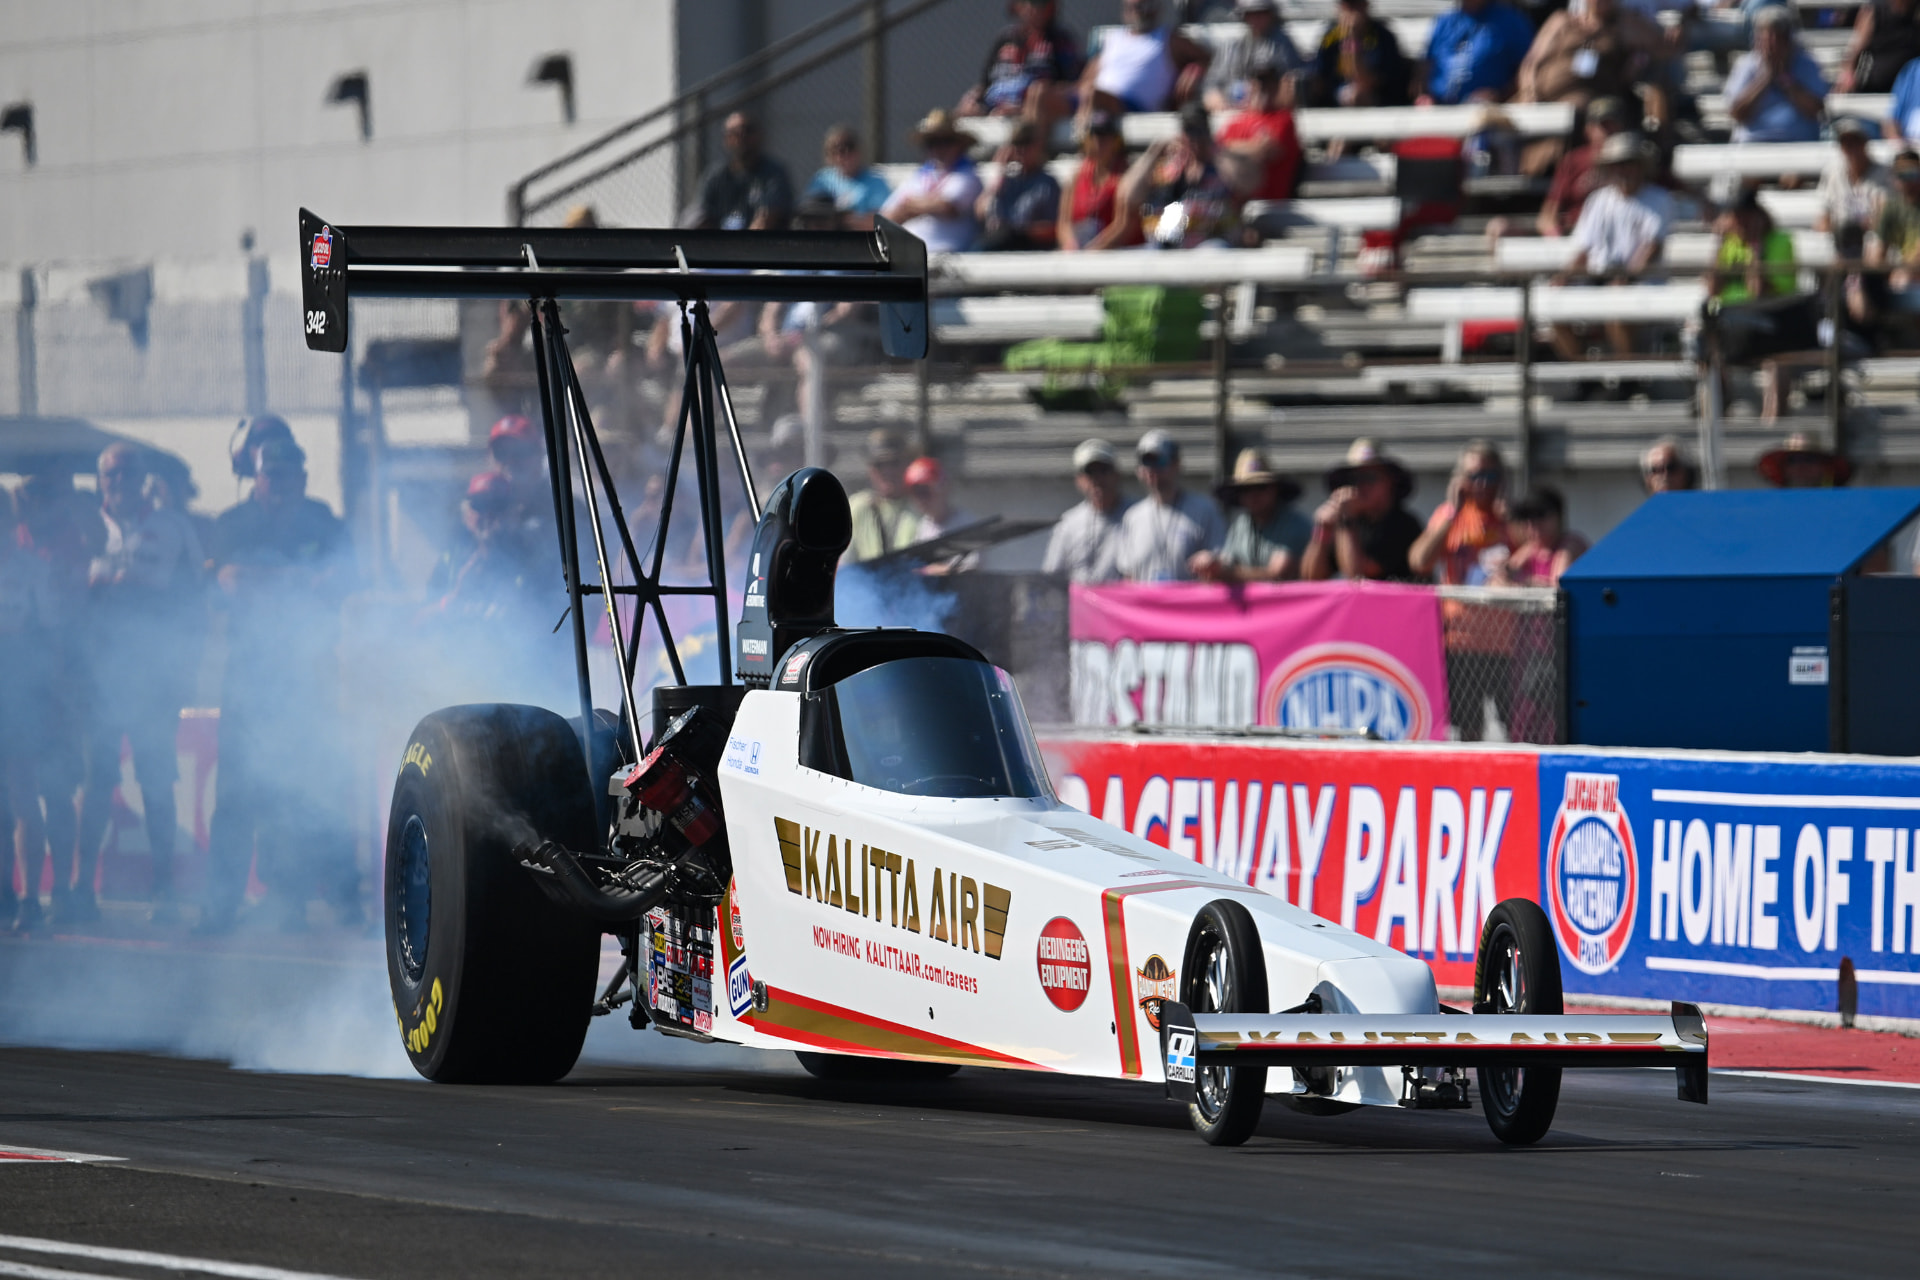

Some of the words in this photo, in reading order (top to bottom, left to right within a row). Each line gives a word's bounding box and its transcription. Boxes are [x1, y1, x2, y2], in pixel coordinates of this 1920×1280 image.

[306, 310, 326, 334] 342
[742, 639, 768, 655] WATERMAN
[729, 736, 747, 752] Fischer
[727, 756, 743, 770] Honda
[744, 766, 760, 776] HONDA
[1341, 784, 1514, 962] PARK
[1650, 818, 1781, 951] HOME
[1793, 823, 1854, 953] OF
[804, 825, 921, 934] KALITTA
[929, 866, 981, 955] AIR
[1566, 877, 1619, 931] RACEWAY
[812, 924, 832, 950] NOW
[832, 930, 862, 960] HIRING
[865, 939, 979, 995] KALITTAAIR.com/careers
[1039, 936, 1088, 963] HEDINGER'S
[1580, 939, 1608, 966] PARK
[731, 967, 751, 1003] GUN
[1040, 963, 1088, 991] EQUIPMENT
[1167, 1064, 1195, 1082] CARRILLO
